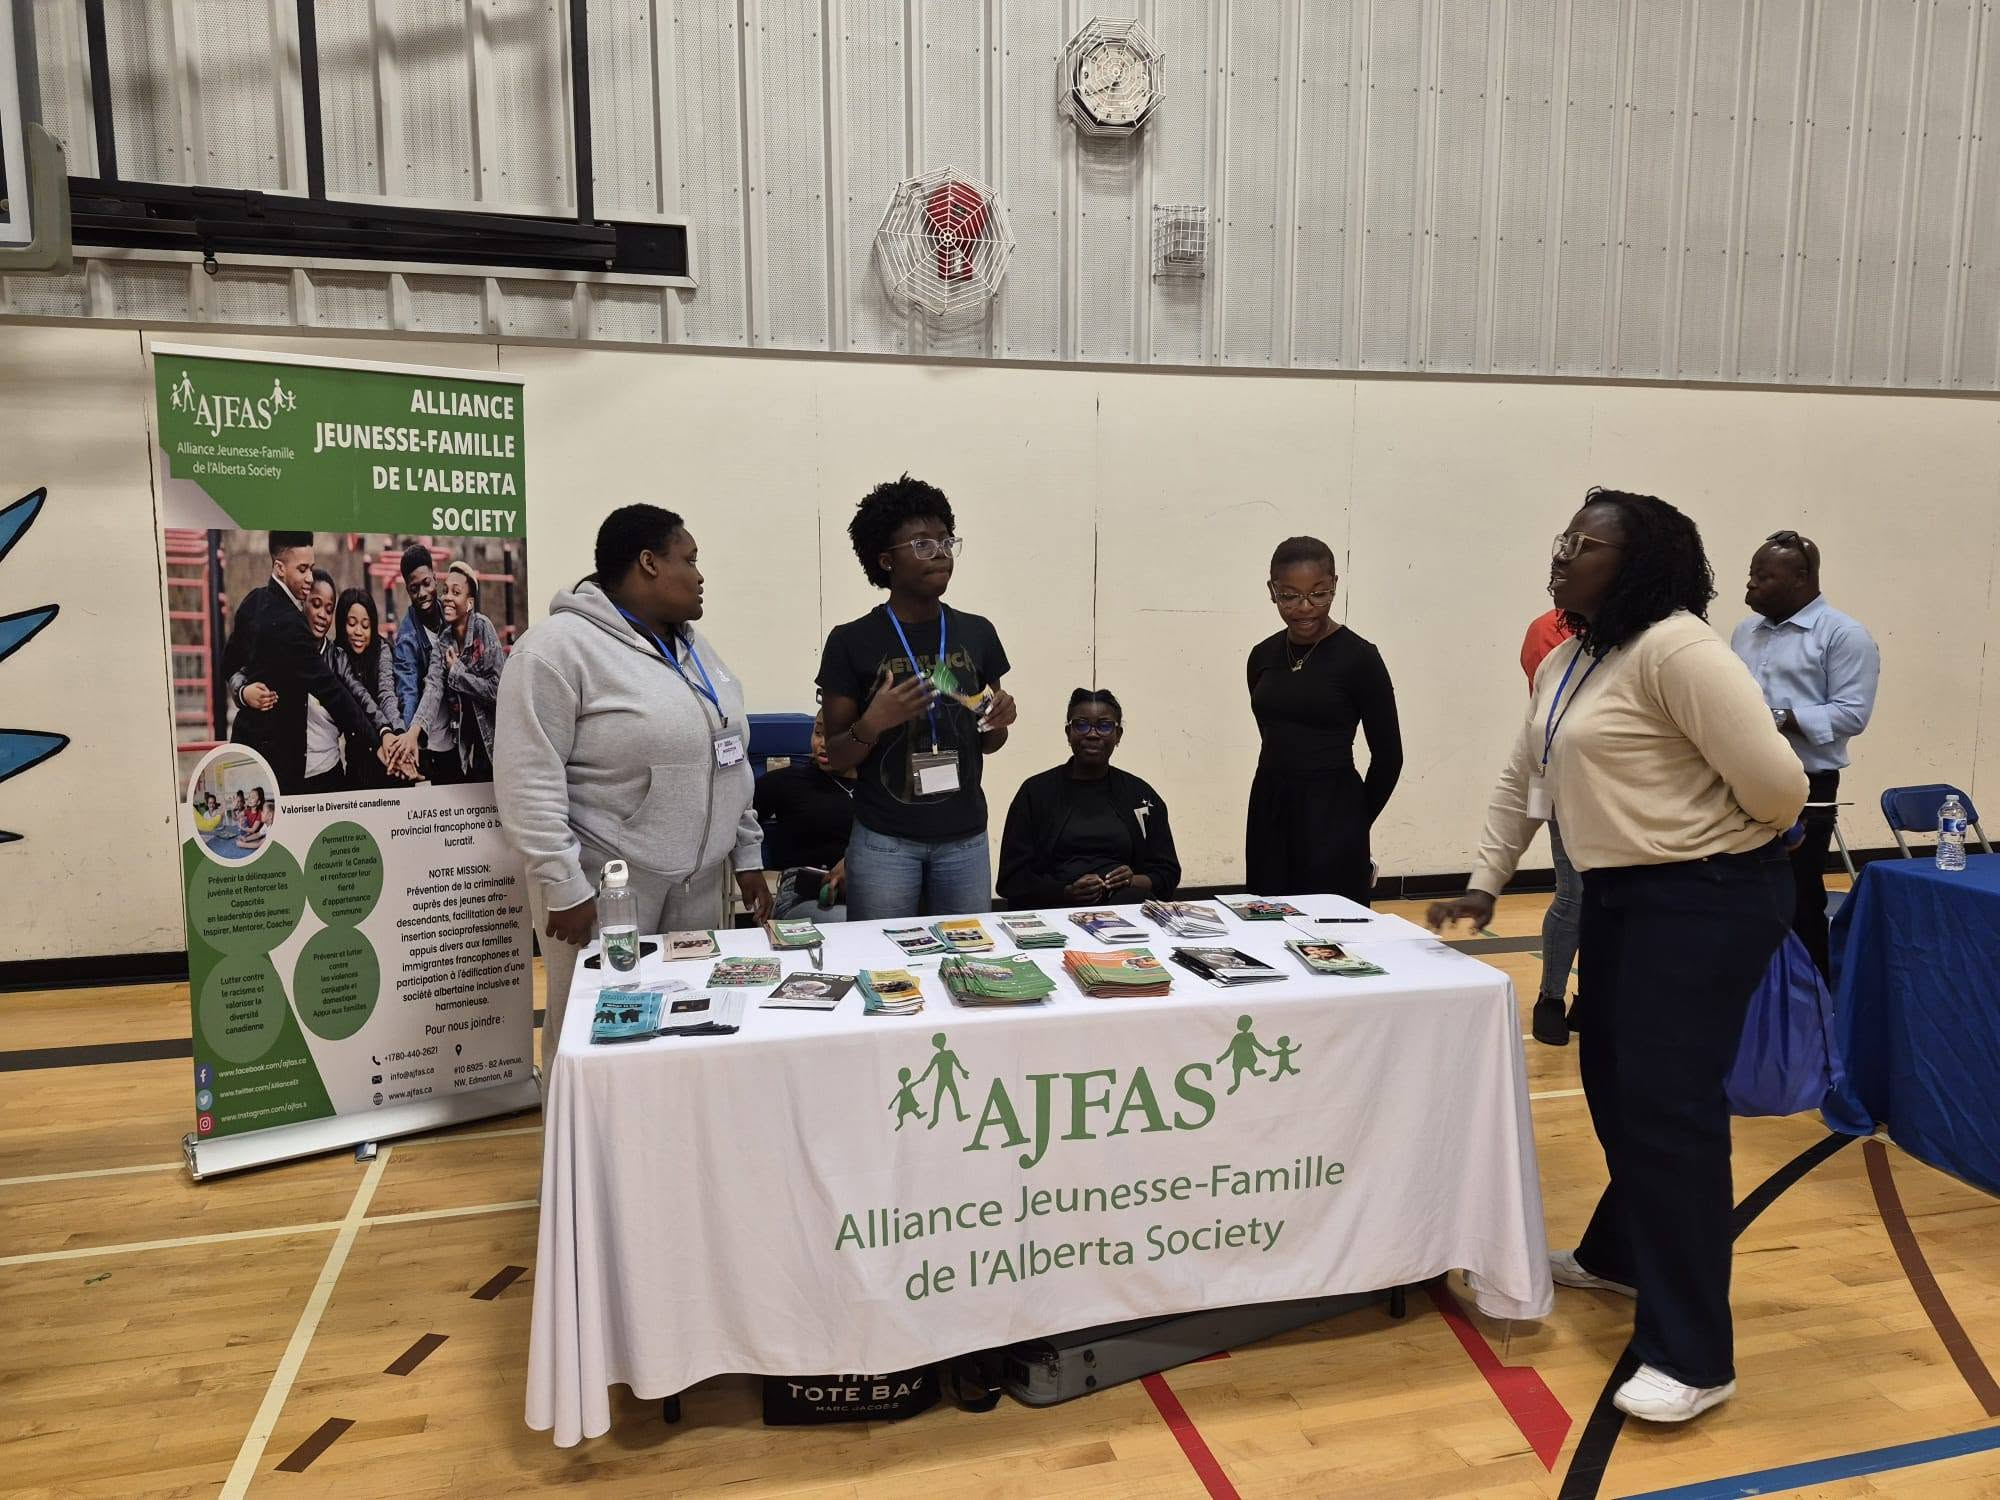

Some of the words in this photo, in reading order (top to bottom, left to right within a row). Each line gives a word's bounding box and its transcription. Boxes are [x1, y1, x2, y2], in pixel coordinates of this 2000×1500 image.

[410, 389, 514, 420] ALLIANCE
[193, 394, 272, 437] AJFAS
[314, 422, 515, 458] JEUNESSE-FAMILLE
[177, 441, 215, 455] Alliance
[217, 445, 295, 459] Jeunesse-Famille
[193, 461, 205, 473] de
[208, 462, 246, 475] l'Alberta
[248, 463, 281, 480] Society
[372, 465, 400, 490] DE
[406, 467, 516, 496] L'ALBERTA
[432, 507, 517, 533] SOCIETY
[281, 803, 315, 814] Valoriser
[317, 804, 324, 812] la
[326, 799, 358, 812] Diversité
[360, 798, 400, 809] canadienne
[407, 809, 438, 820] L'AJFAS
[440, 808, 452, 817] est
[454, 808, 464, 816] un
[466, 804, 498, 817] organis
[391, 824, 432, 839] provincial
[434, 820, 485, 833] francophone
[322, 835, 353, 845] Permettre
[444, 836, 475, 847] lucratif.
[330, 848, 350, 858] jeunes
[352, 846, 360, 854] de
[314, 860, 343, 870] découvrir
[353, 856, 377, 866] Canada
[428, 868, 454, 878] NOTRE
[456, 864, 492, 876] MISSION:
[208, 874, 236, 884] Prévenir
[237, 874, 244, 882] la
[246, 870, 286, 882] délinquance
[208, 886, 234, 899] juvénile
[243, 884, 277, 894] Renforcer
[278, 882, 288, 891] les
[406, 884, 450, 897] Prévention
[452, 882, 462, 891] de
[464, 881, 472, 890] la
[474, 876, 516, 888] criminalité
[412, 899, 441, 912] auprès
[443, 897, 458, 906] des
[459, 894, 486, 908] jeunes
[488, 892, 508, 902] afro-
[217, 911, 252, 924] leadership
[254, 910, 266, 918] des
[266, 920, 294, 929] Coacher
[396, 914, 452, 928] descendants,
[452, 908, 495, 921] facilitation
[496, 906, 506, 916] de
[508, 904, 523, 914] leur
[402, 930, 436, 942] insertion
[410, 946, 438, 958] appuis
[440, 942, 464, 952] divers
[466, 940, 480, 949] aux
[482, 936, 512, 946] familles
[402, 957, 454, 972] immigrantes
[456, 949, 510, 964] francophones
[512, 948, 520, 957] et
[220, 976, 241, 985] Lutter
[242, 972, 265, 982] contre
[396, 974, 448, 990] participation
[450, 970, 456, 980] à
[221, 990, 228, 998] le
[229, 988, 256, 996] racisme
[257, 985, 264, 993] et
[402, 989, 432, 1002] société
[434, 984, 475, 997] albertaine
[476, 979, 510, 991] inclusive
[512, 977, 520, 986] et
[255, 998, 262, 1006] la
[225, 1022, 264, 1034] canadienne
[425, 1024, 446, 1036] Pour
[448, 1021, 469, 1031] nous
[470, 1016, 500, 1030] joindre
[468, 1074, 502, 1085] Edmonton,
[504, 1070, 513, 1079] AB
[388, 1086, 433, 1100] www.ajfas.ca
[963, 1062, 1216, 1169] AJFAS
[834, 1199, 1003, 1251] Alliance
[1014, 1155, 1346, 1223] Jeunesse-Famille
[905, 1260, 955, 1300] de
[970, 1236, 1134, 1287] l'Alberta
[1147, 1217, 1285, 1262] Society
[788, 1382, 861, 1402] TOTE
